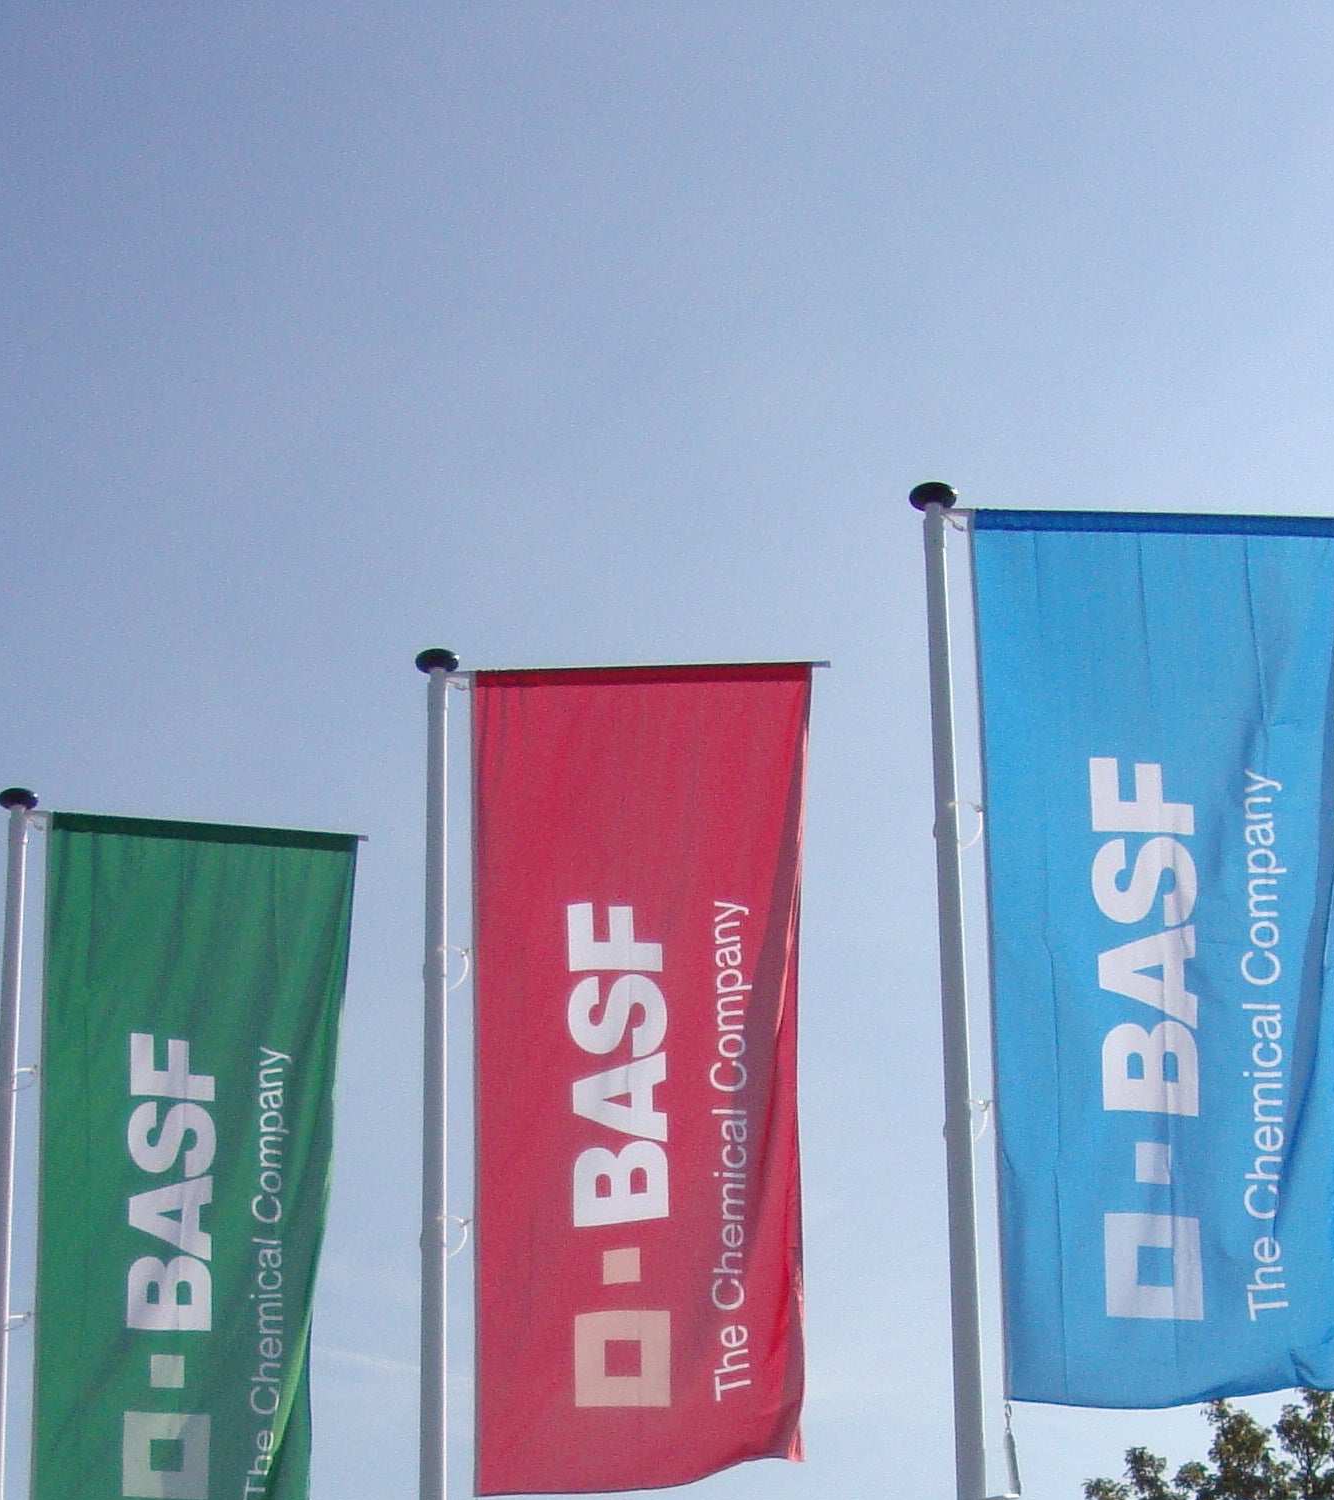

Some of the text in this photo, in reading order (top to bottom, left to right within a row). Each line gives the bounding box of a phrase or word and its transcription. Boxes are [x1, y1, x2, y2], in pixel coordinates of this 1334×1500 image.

[567, 902, 670, 1228] BASF
[1089, 756, 1200, 1116] BASF
[1239, 770, 1289, 1321] The Chemical Company
[126, 1033, 217, 1331] BASF
[253, 1046, 292, 1224] Company
[710, 900, 752, 1402] The Chemical Company
[250, 1230, 282, 1415] Chemical
